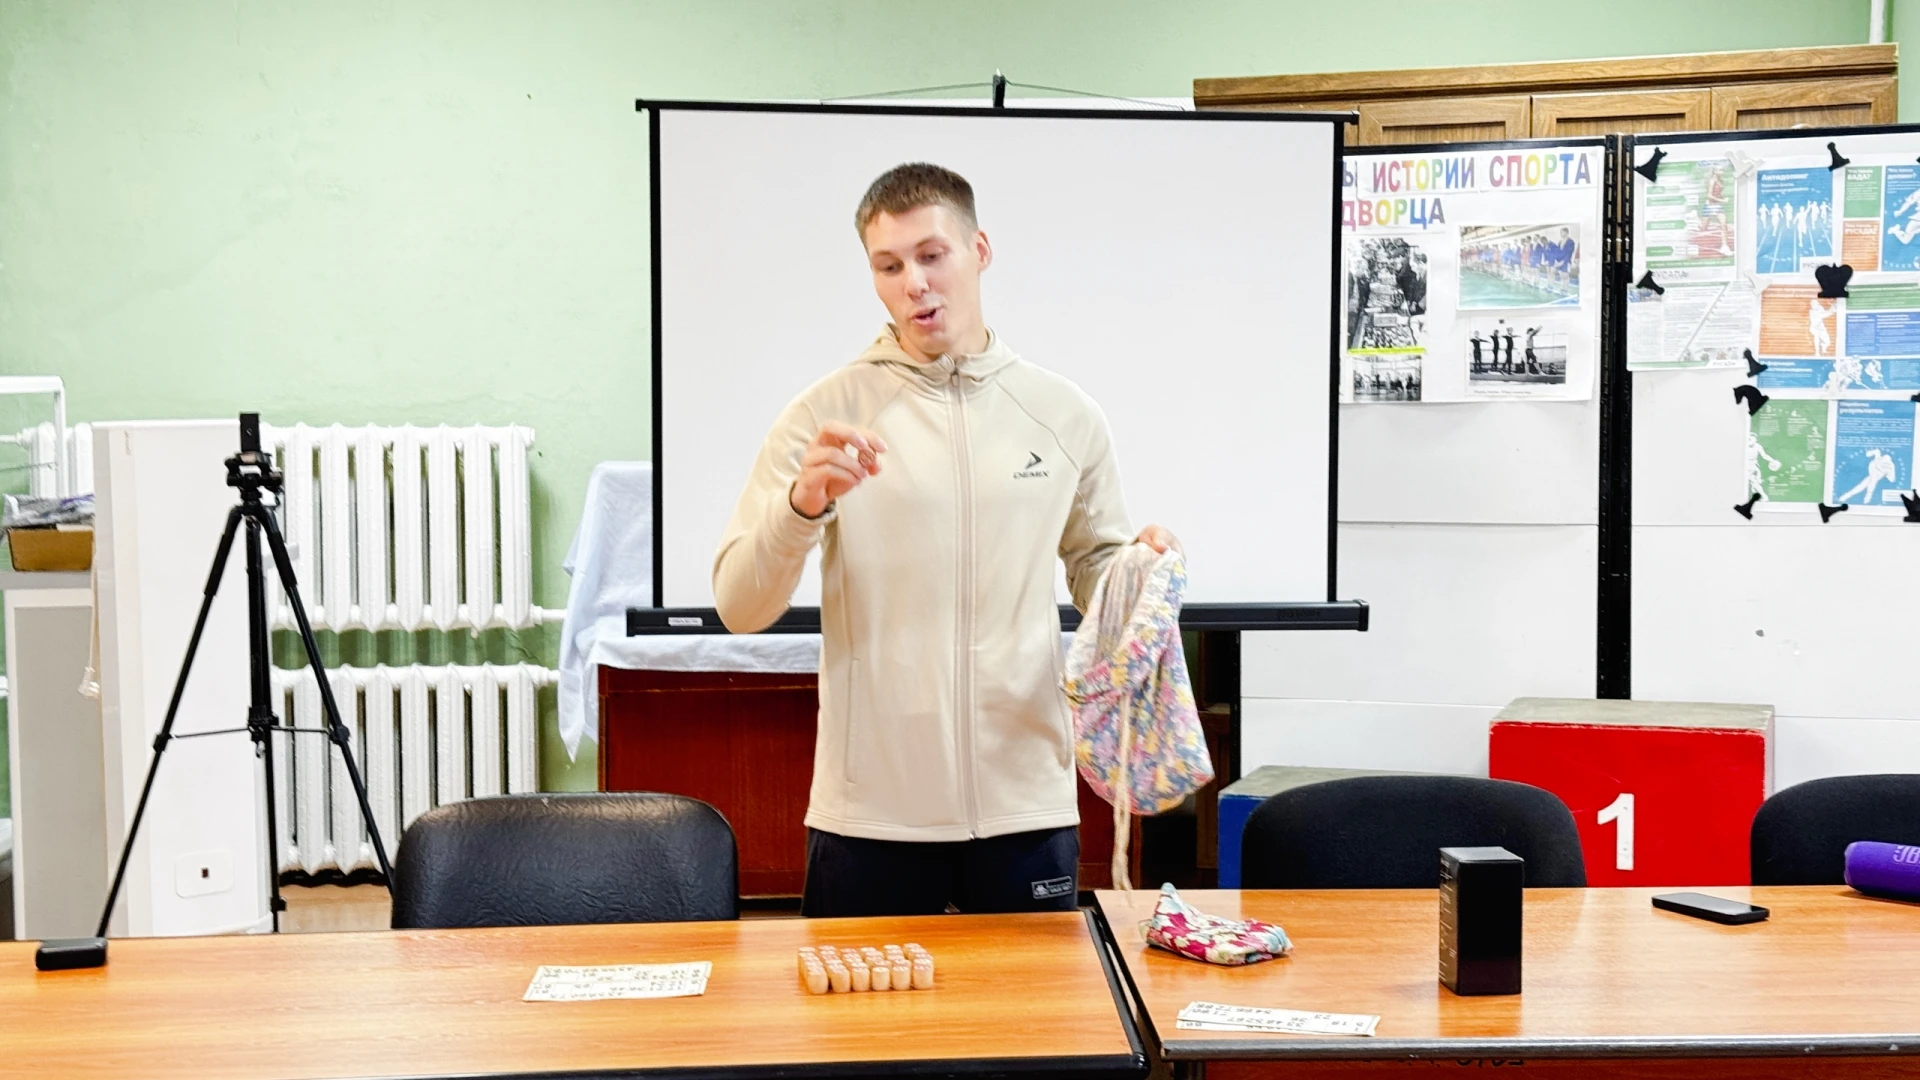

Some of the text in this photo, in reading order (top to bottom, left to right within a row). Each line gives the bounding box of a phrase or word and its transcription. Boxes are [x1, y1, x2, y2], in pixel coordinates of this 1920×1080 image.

[1373, 157, 1475, 193] ИСТОРИИ
[1489, 152, 1591, 187] СПОРТА
[1342, 198, 1446, 232] ДВОРЦА
[1597, 793, 1635, 871] 1
[1892, 845, 1920, 865] JB
